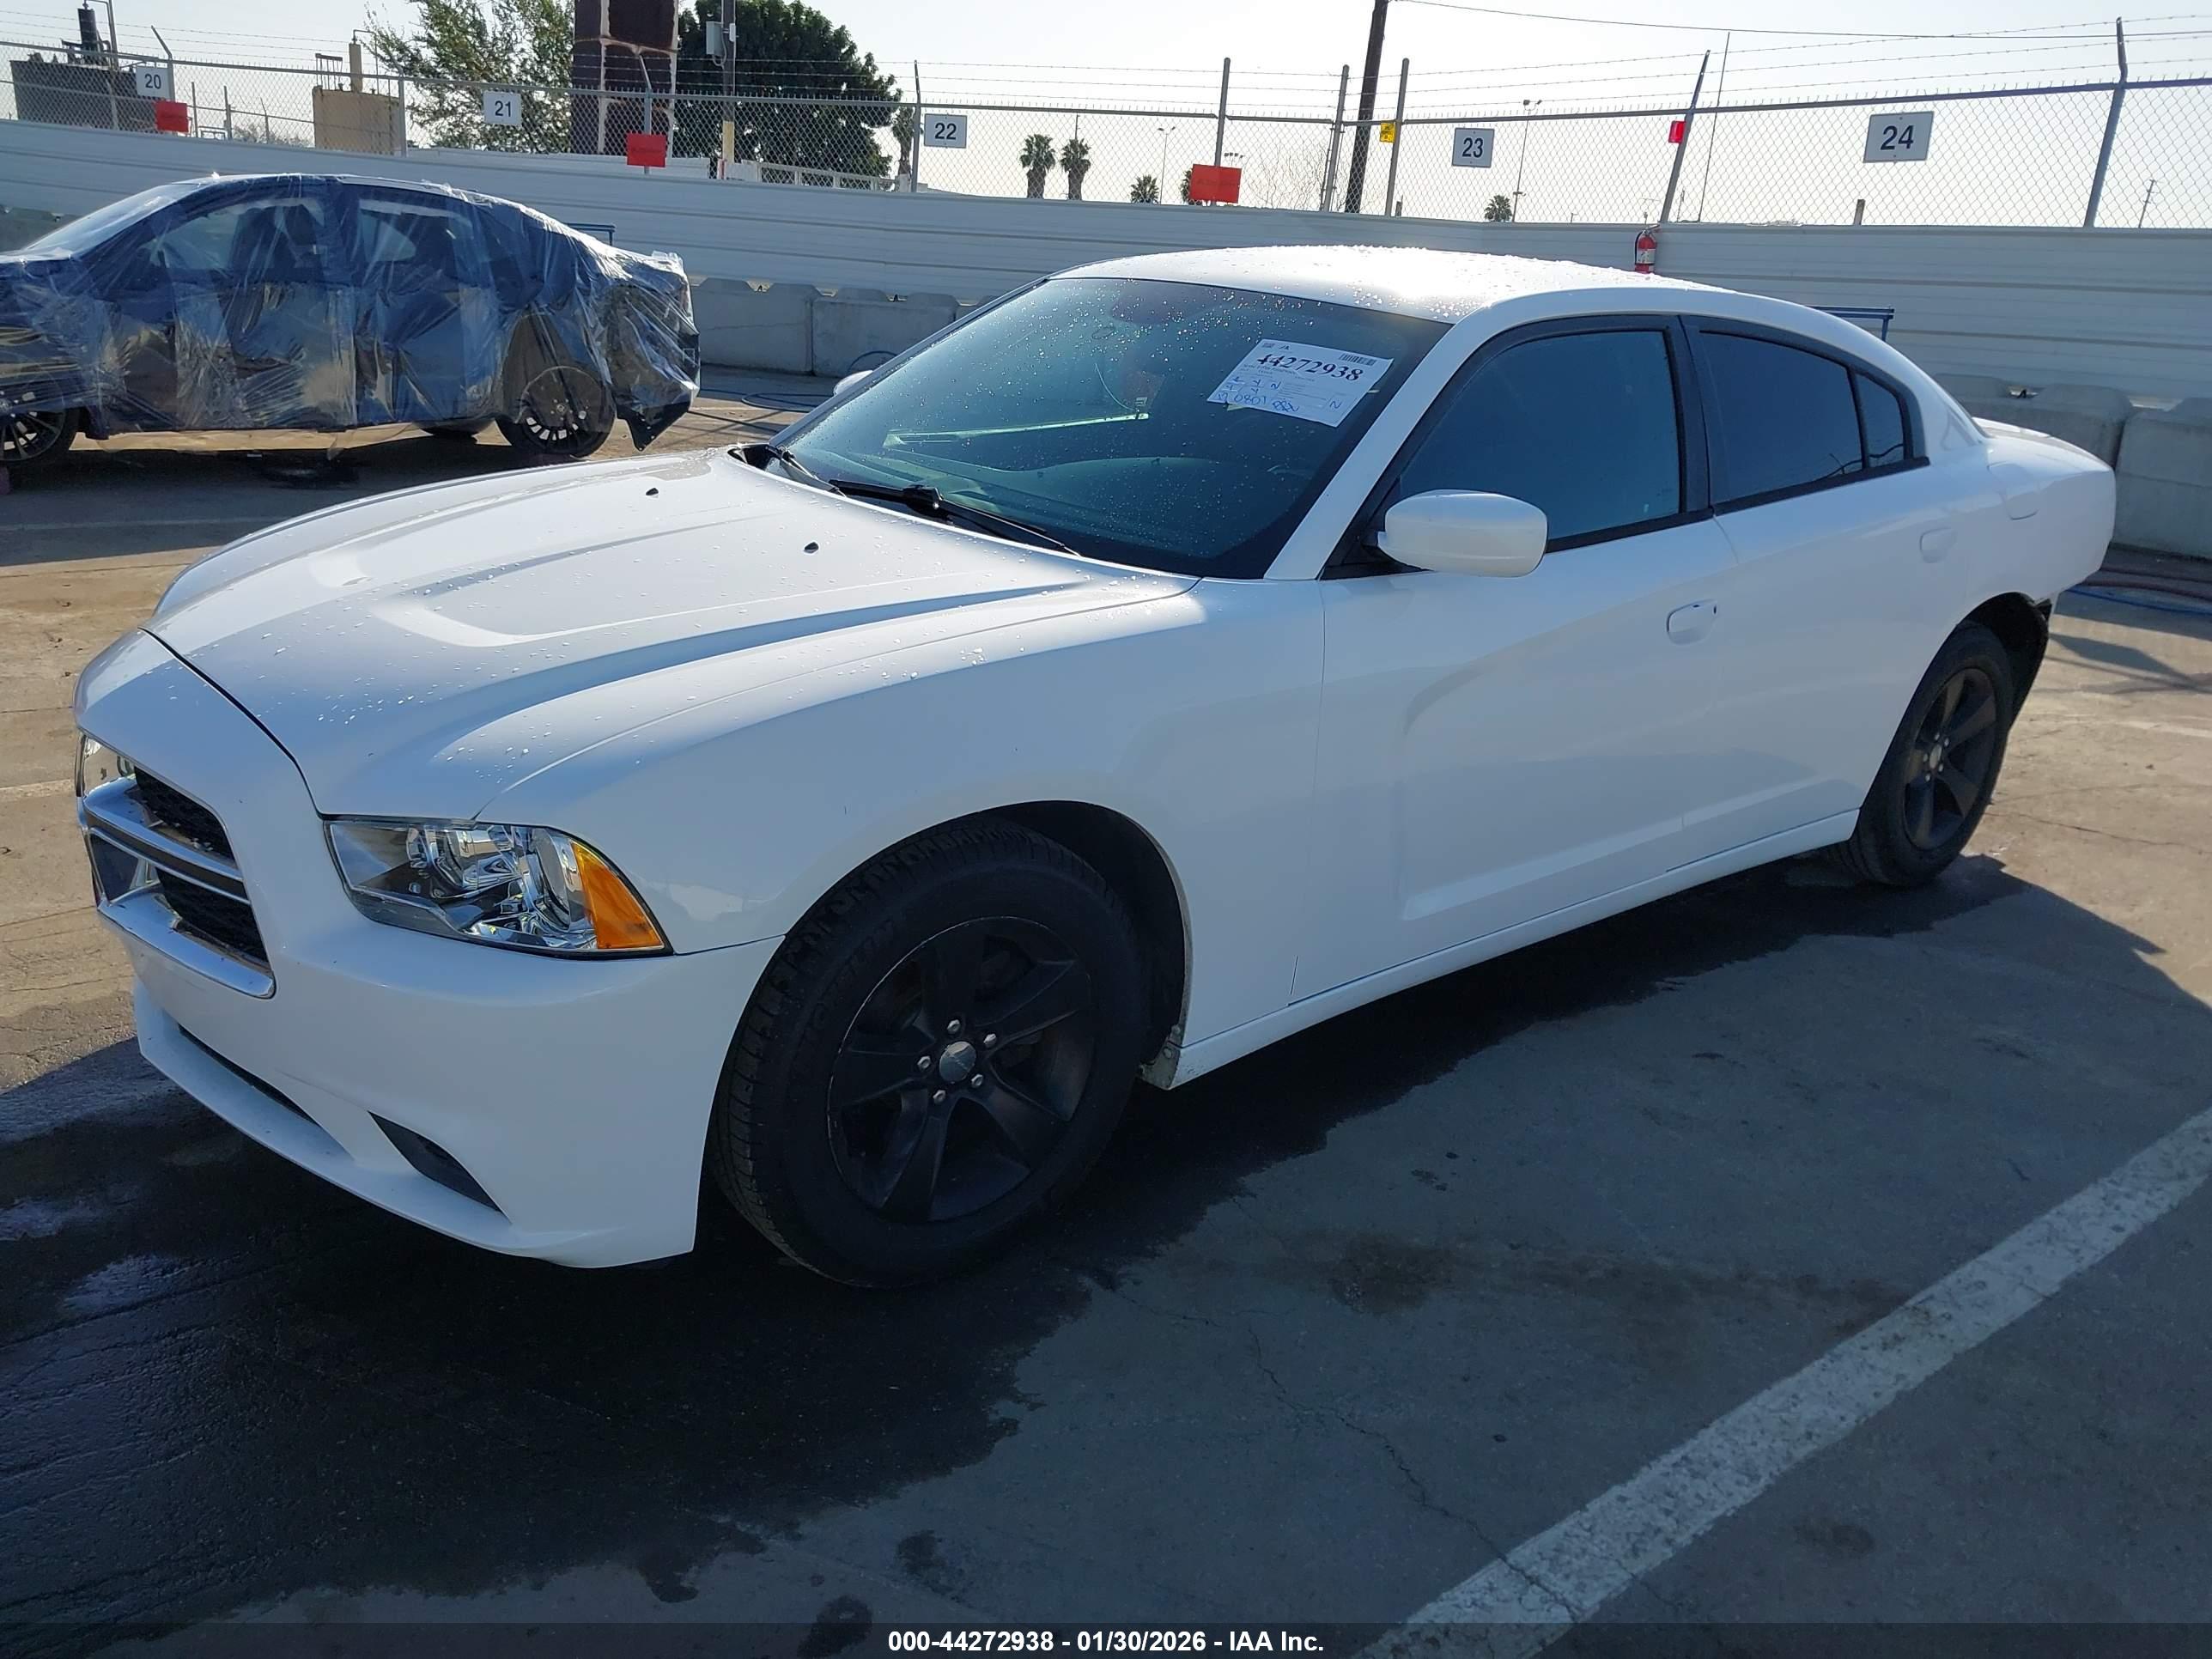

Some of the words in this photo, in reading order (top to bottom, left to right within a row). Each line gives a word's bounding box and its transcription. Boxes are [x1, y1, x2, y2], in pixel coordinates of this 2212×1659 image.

[144, 73, 162, 90] 20
[495, 100, 511, 118] 21
[934, 122, 957, 140] 22
[1880, 125, 1915, 151] 24
[1462, 137, 1484, 159] 23
[1257, 353, 1364, 381] 44272938
